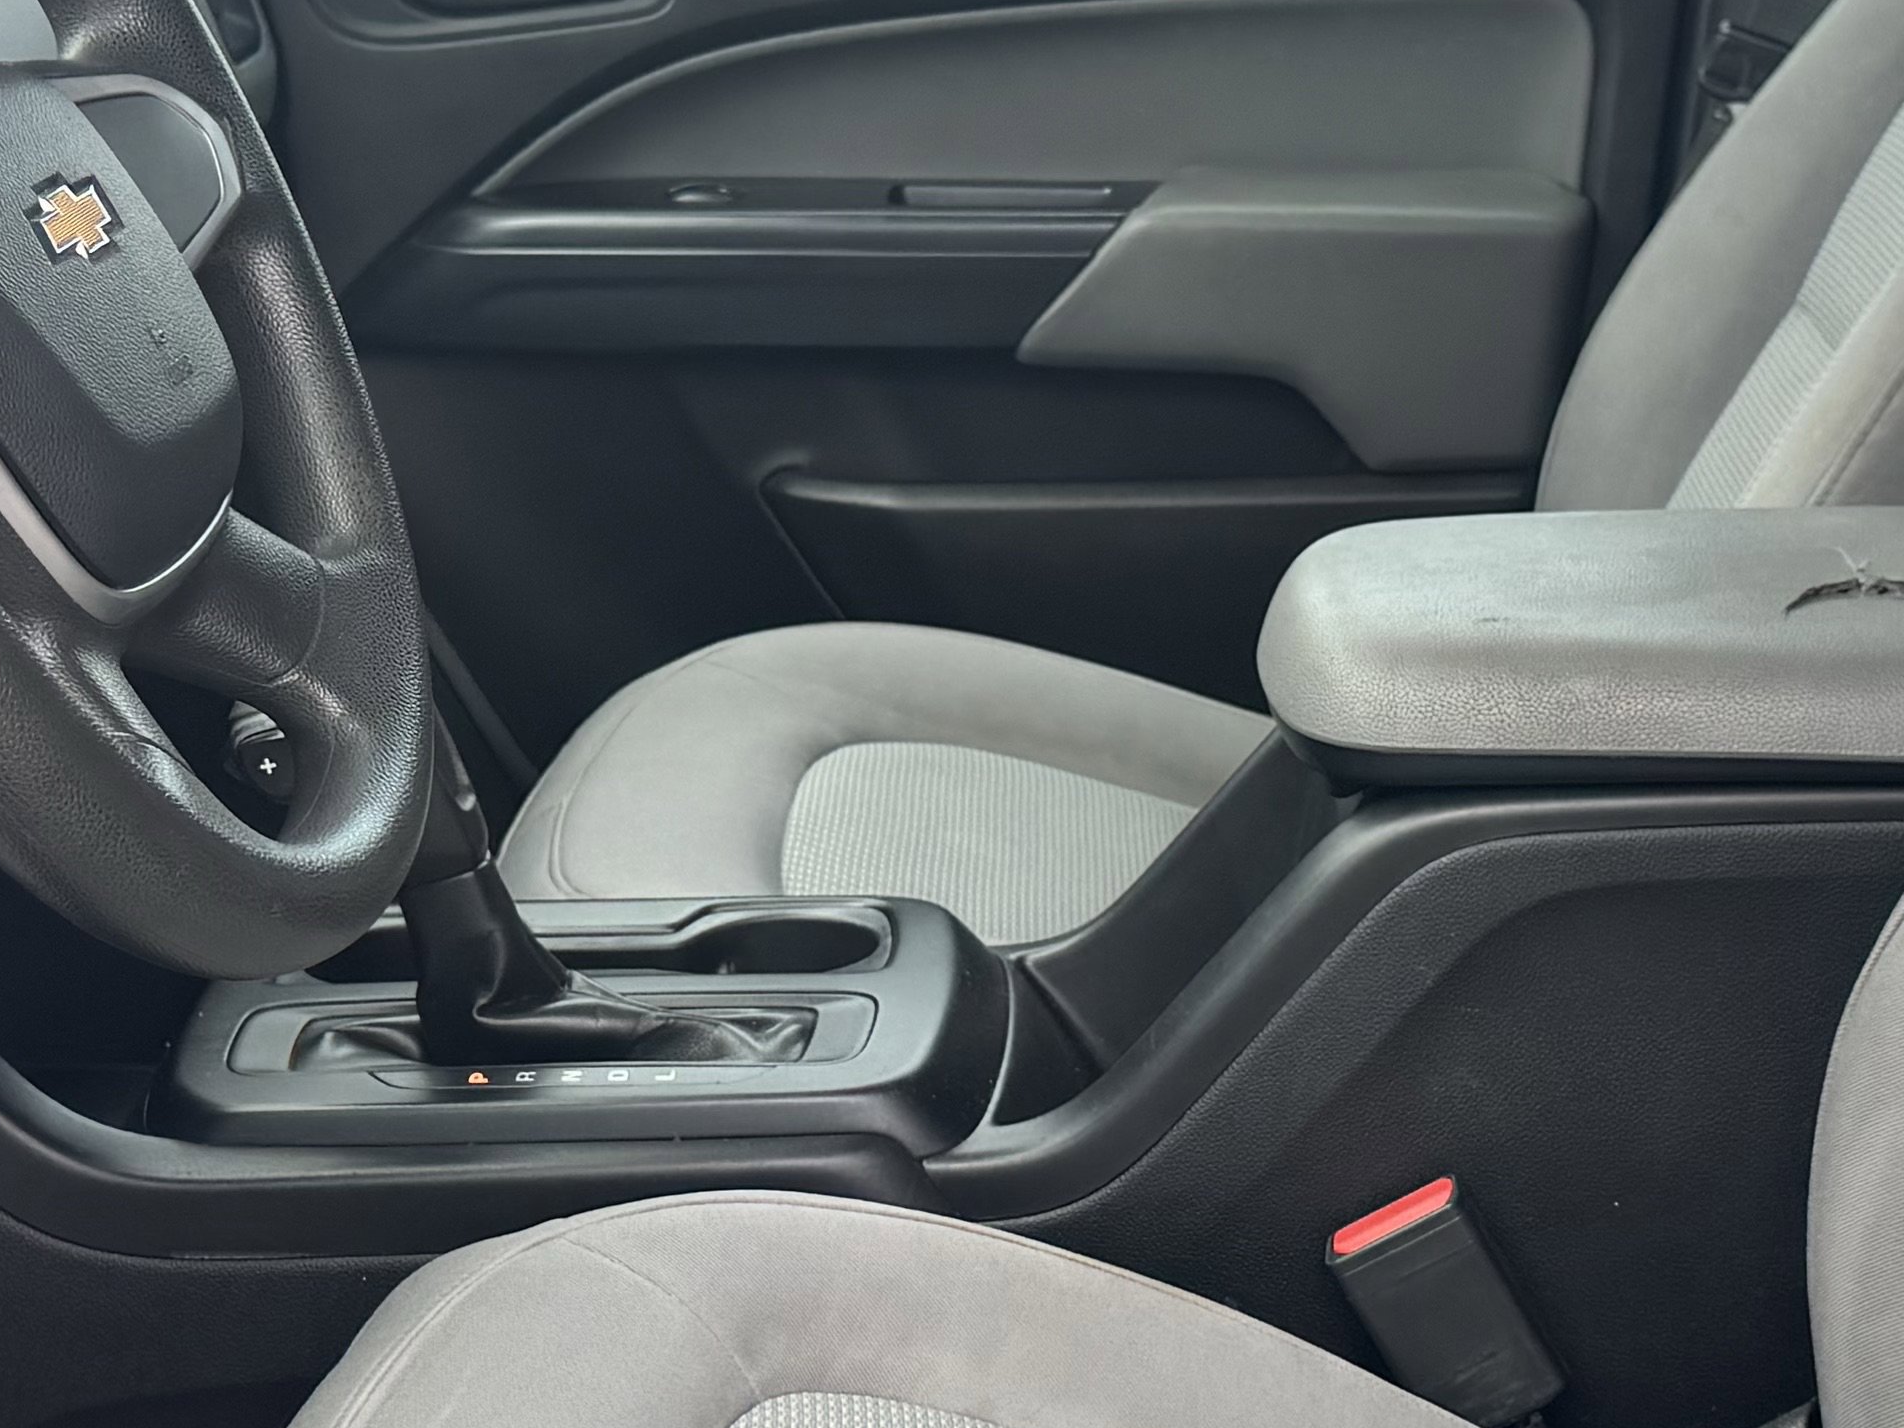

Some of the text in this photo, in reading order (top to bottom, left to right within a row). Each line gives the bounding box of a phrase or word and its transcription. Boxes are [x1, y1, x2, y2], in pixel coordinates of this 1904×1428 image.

[468, 1069, 676, 1084] P R N D L
